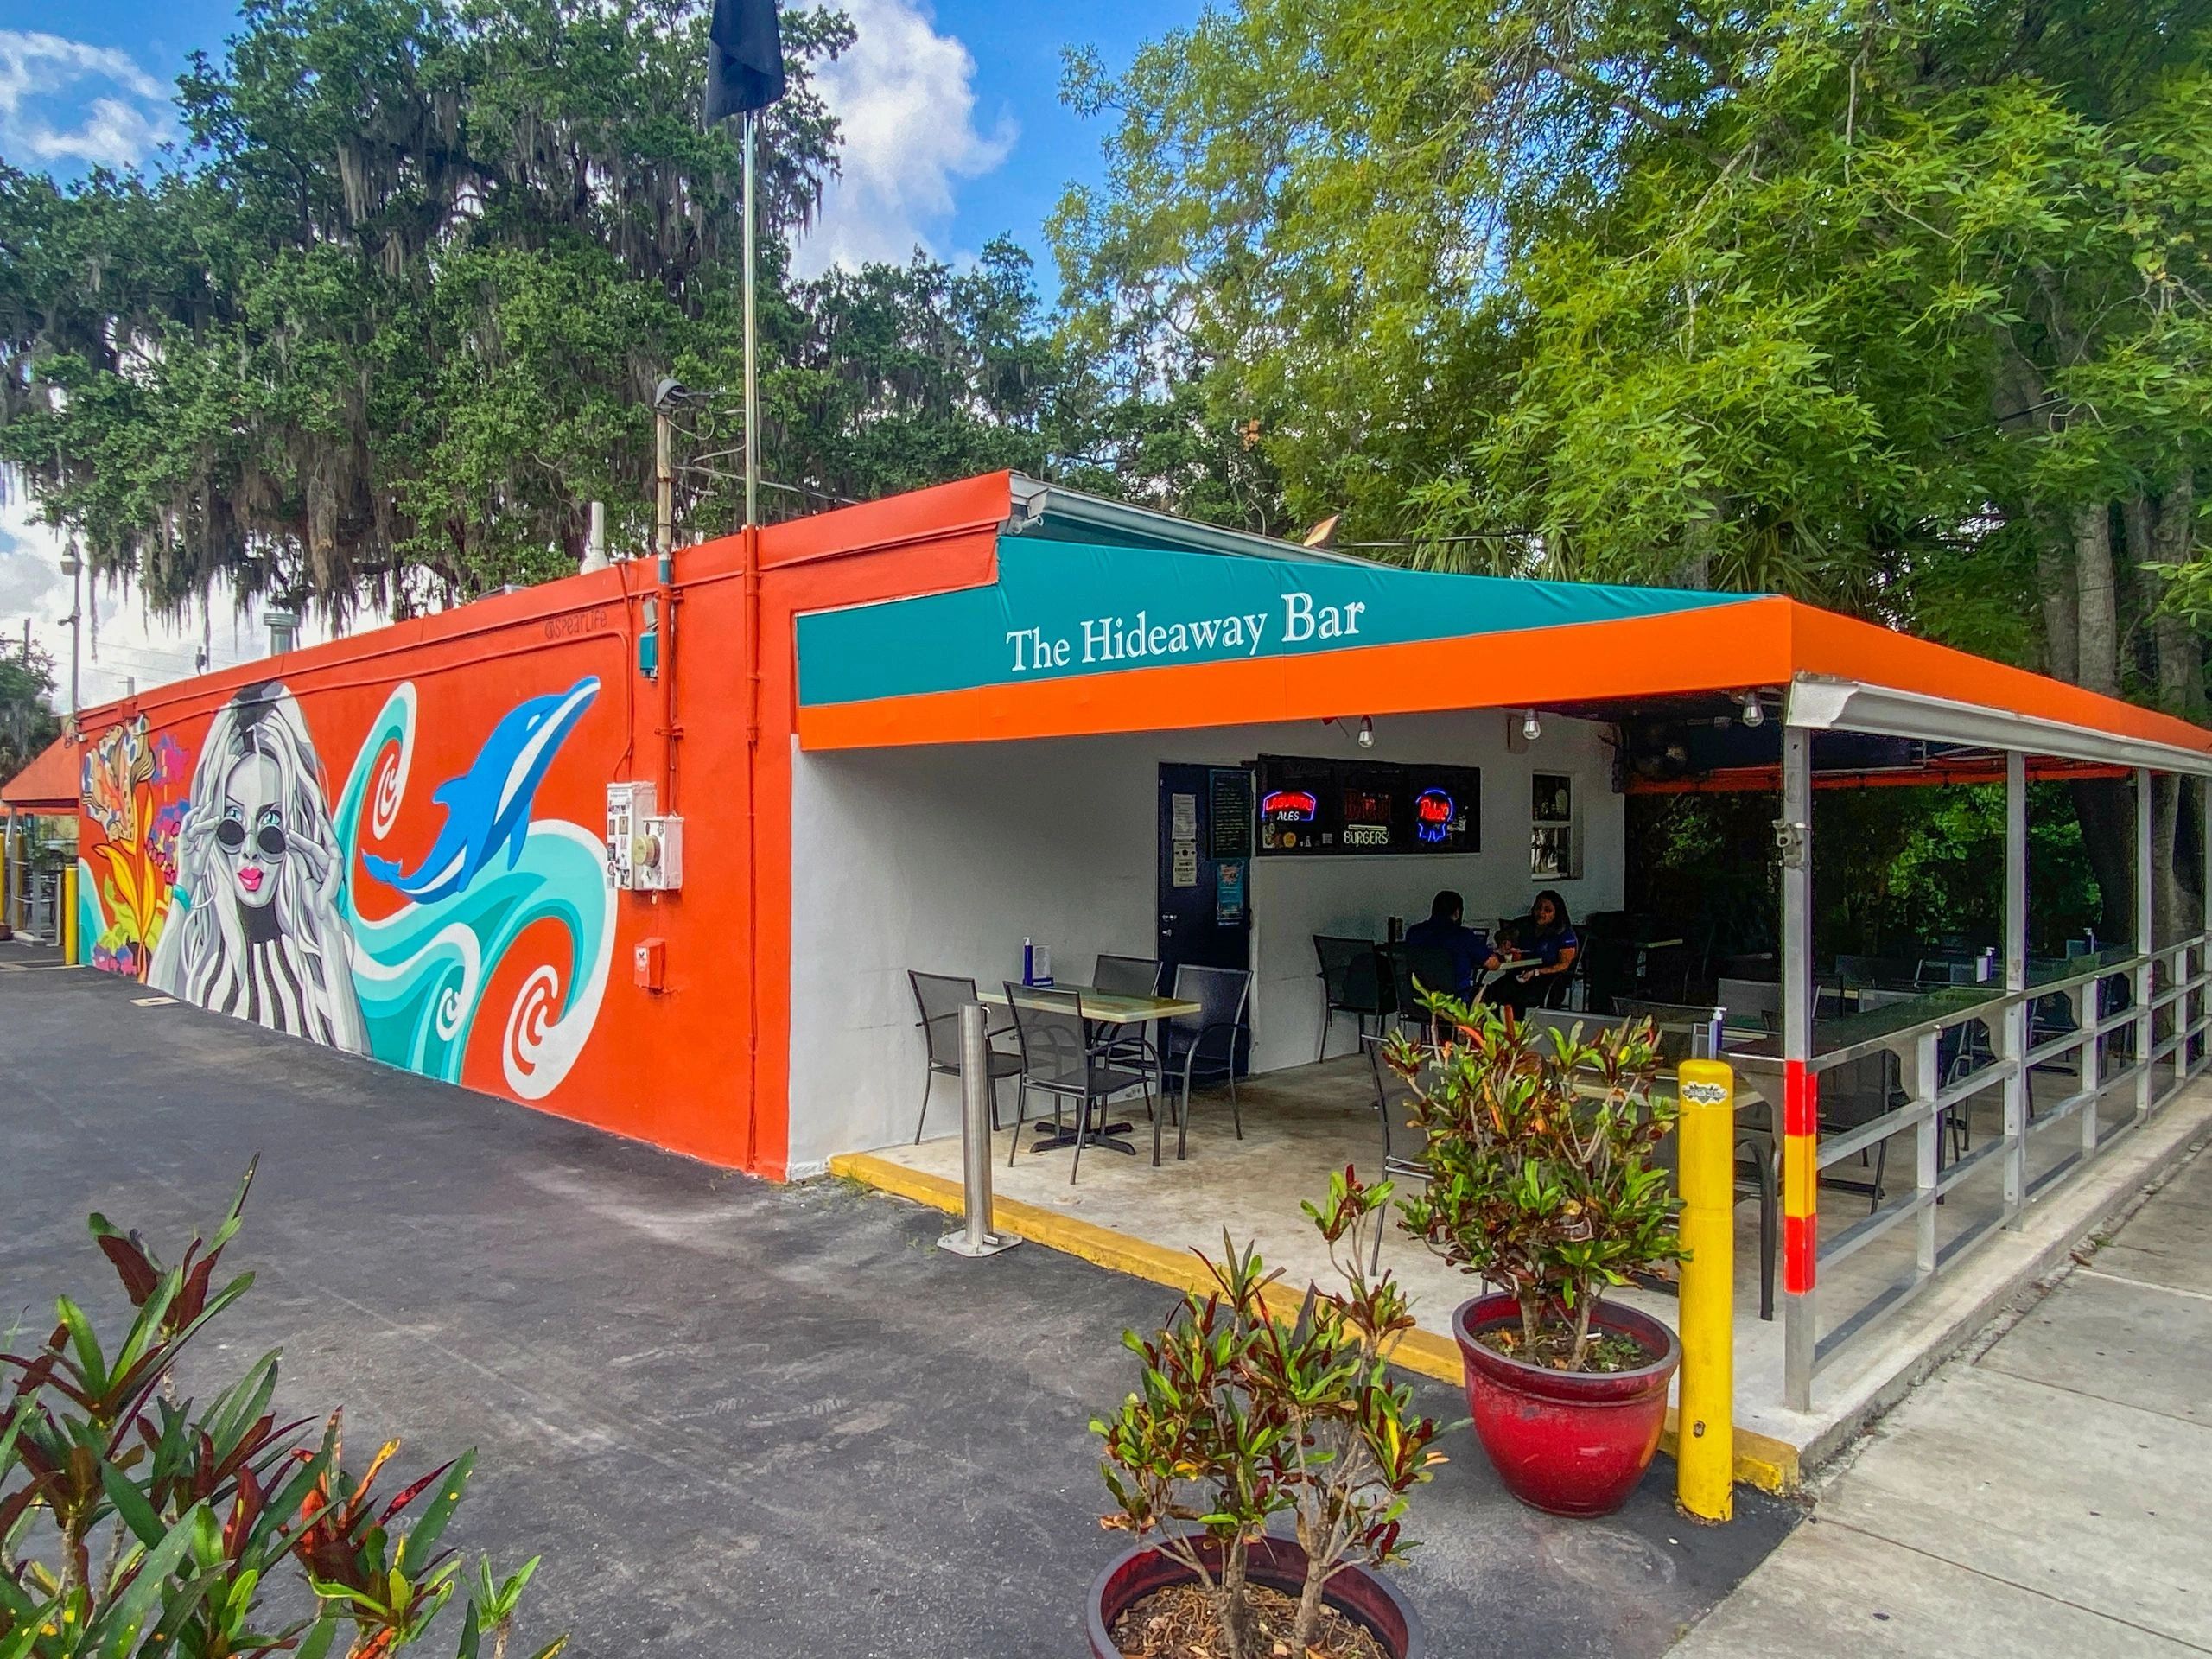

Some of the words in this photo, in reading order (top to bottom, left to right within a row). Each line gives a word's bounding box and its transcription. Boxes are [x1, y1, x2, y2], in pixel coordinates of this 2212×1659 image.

[1005, 626, 1071, 671] The
[1080, 610, 1268, 664] Hideaway
[1280, 592, 1366, 643] Bar
[1276, 810, 1300, 822] ALES
[1344, 830, 1389, 845] BURGERS
